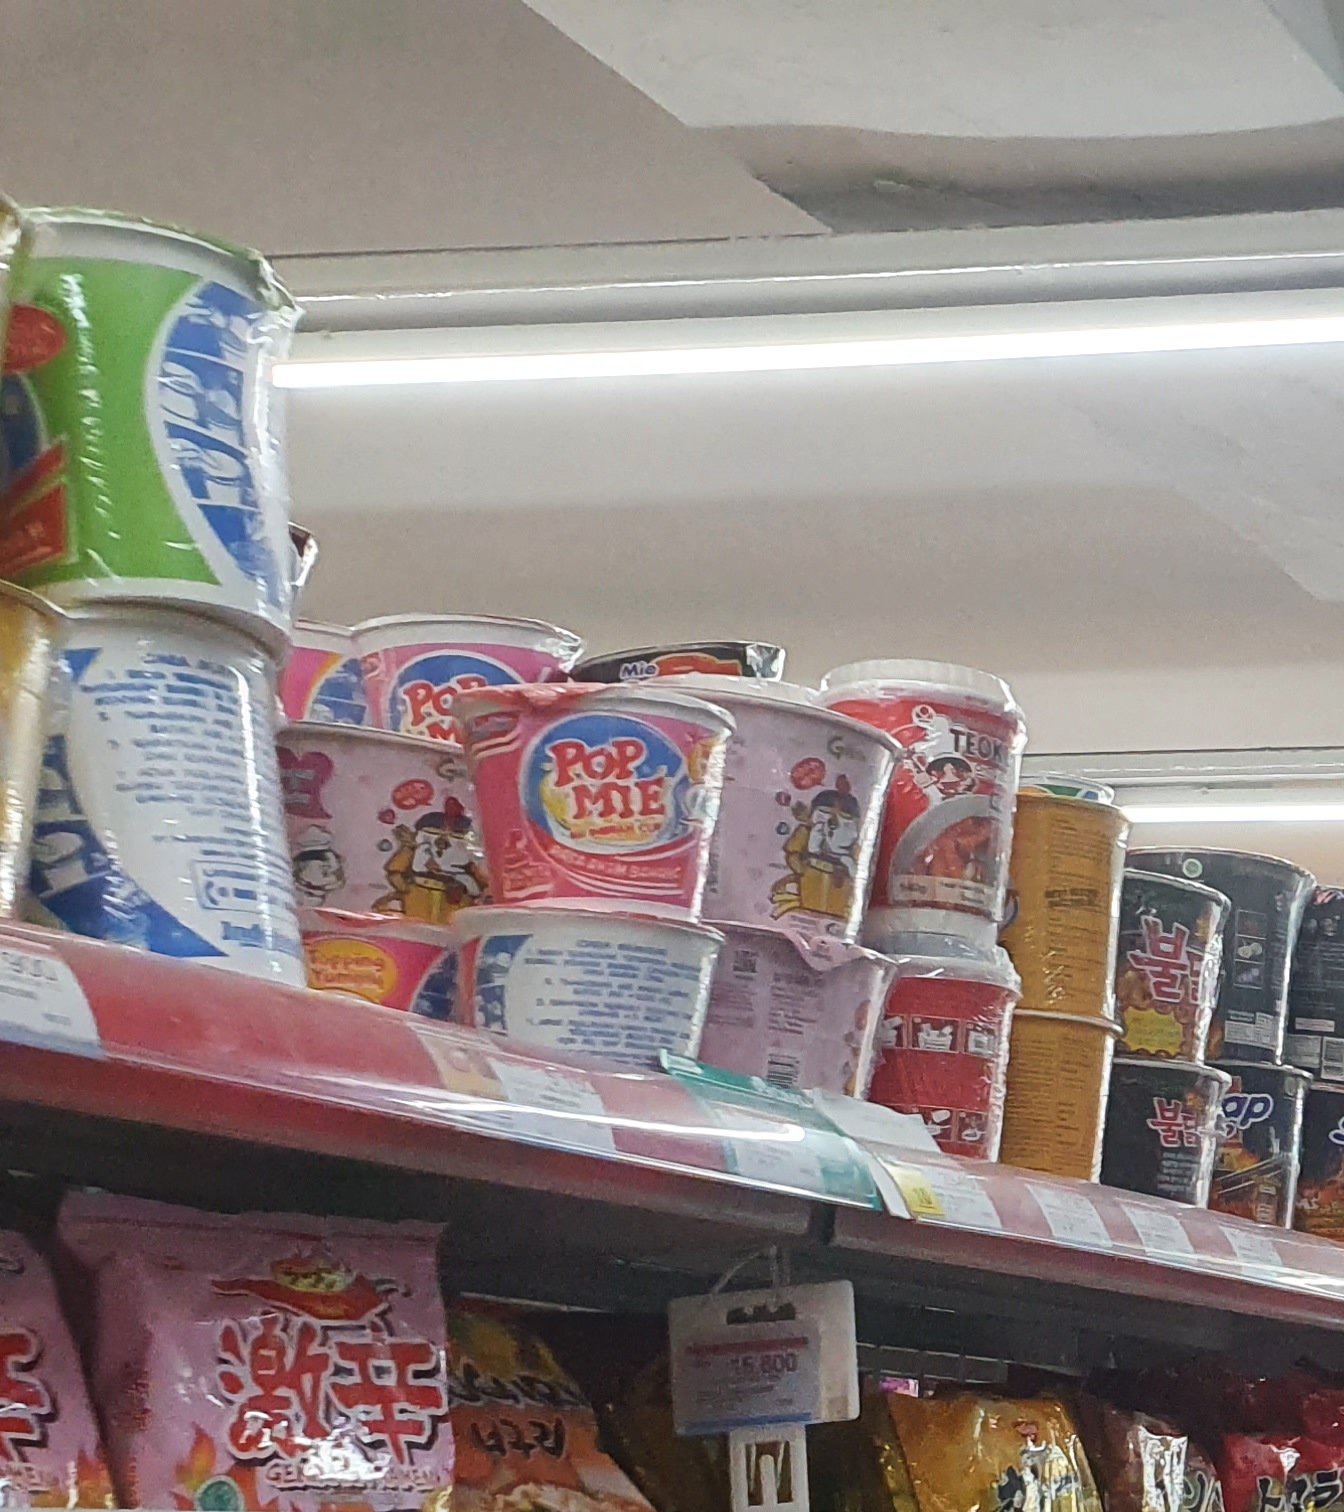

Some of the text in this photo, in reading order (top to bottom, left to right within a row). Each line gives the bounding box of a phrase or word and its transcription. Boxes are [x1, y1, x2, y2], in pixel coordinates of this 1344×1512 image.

[620, 661, 659, 679] Mie
[547, 737, 646, 788] POP
[571, 776, 666, 820] MIE
